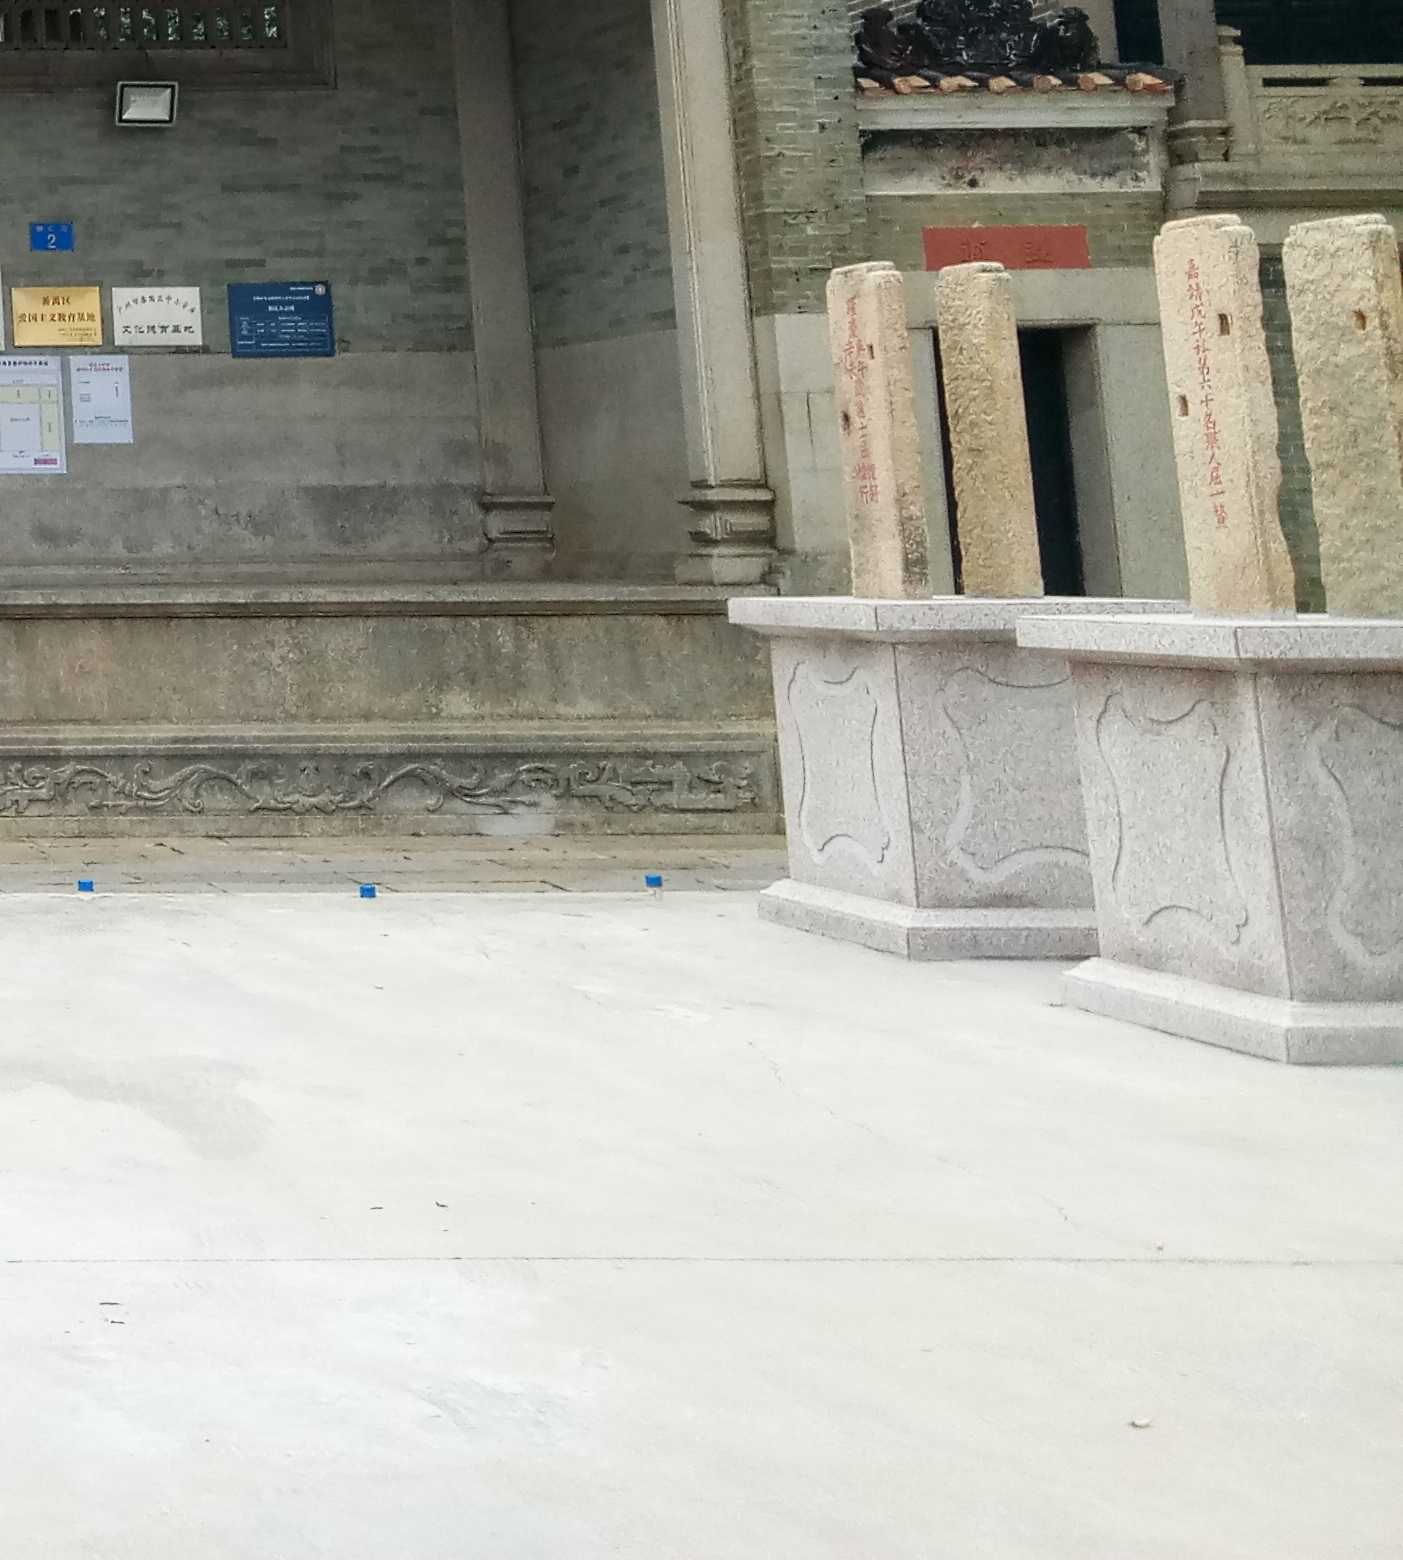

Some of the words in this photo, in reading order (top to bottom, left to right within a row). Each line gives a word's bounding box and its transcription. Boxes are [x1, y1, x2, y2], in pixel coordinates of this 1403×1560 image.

[46, 233, 57, 249] 2
[18, 312, 97, 324] 爱国主义教育基地
